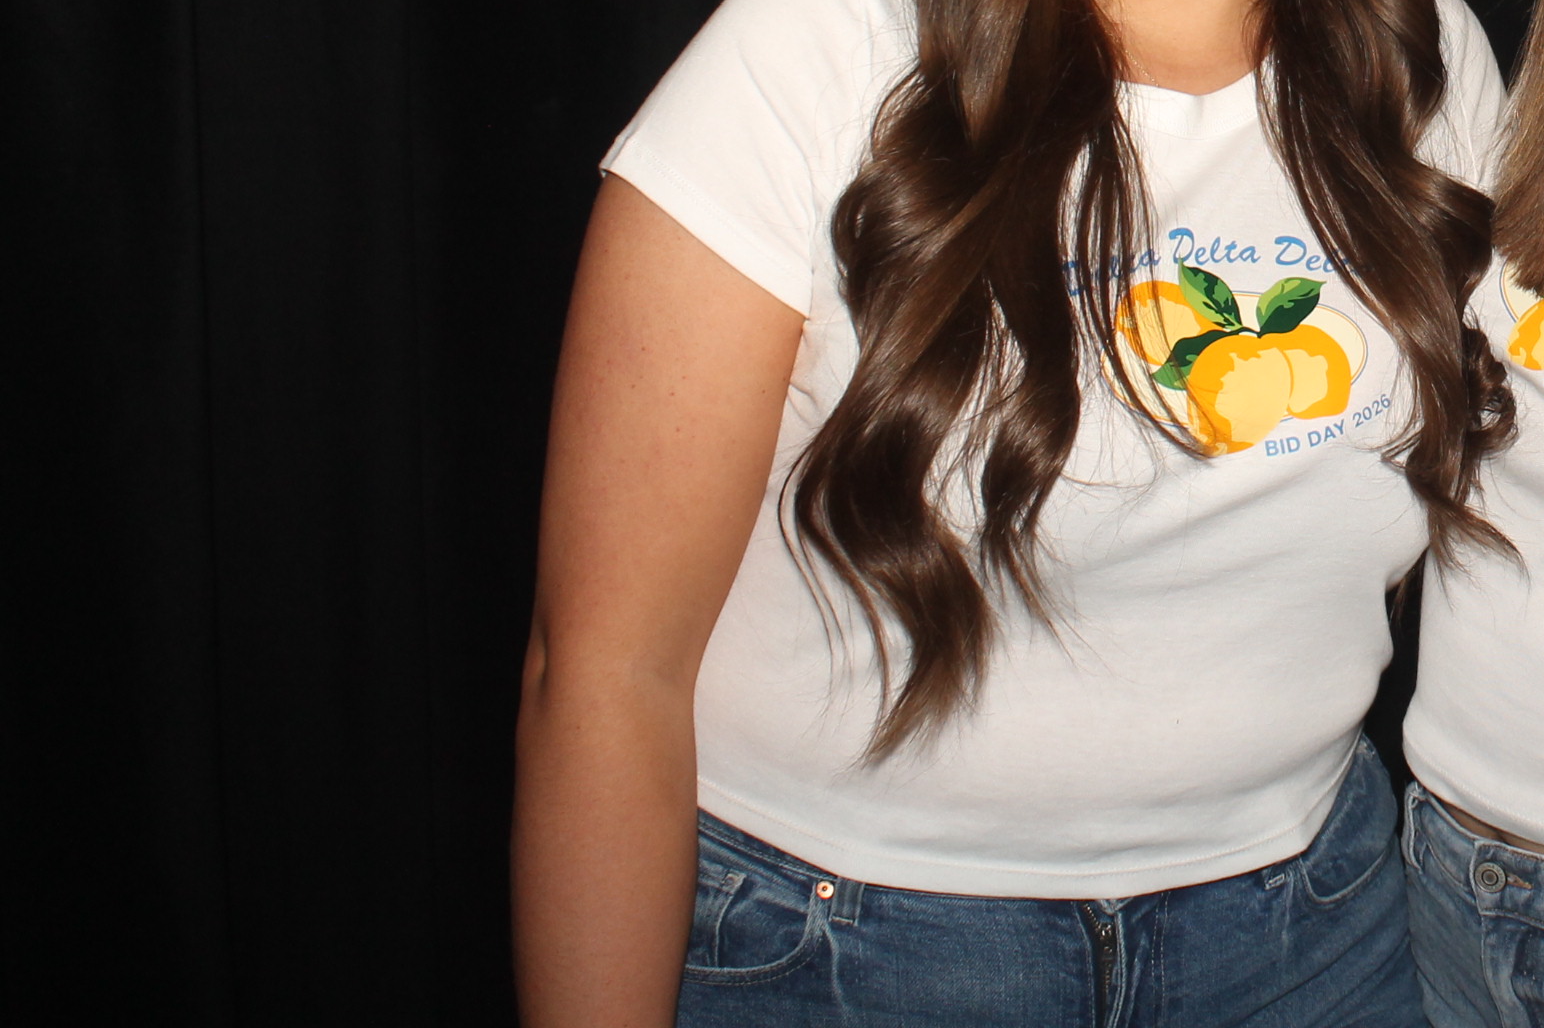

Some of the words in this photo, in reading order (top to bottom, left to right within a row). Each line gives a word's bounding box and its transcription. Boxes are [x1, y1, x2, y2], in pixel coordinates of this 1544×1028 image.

[1168, 227, 1261, 266] Delta
[1264, 436, 1301, 457] BID
[1307, 418, 1345, 448] DAY
[1352, 393, 1391, 428] 2026
